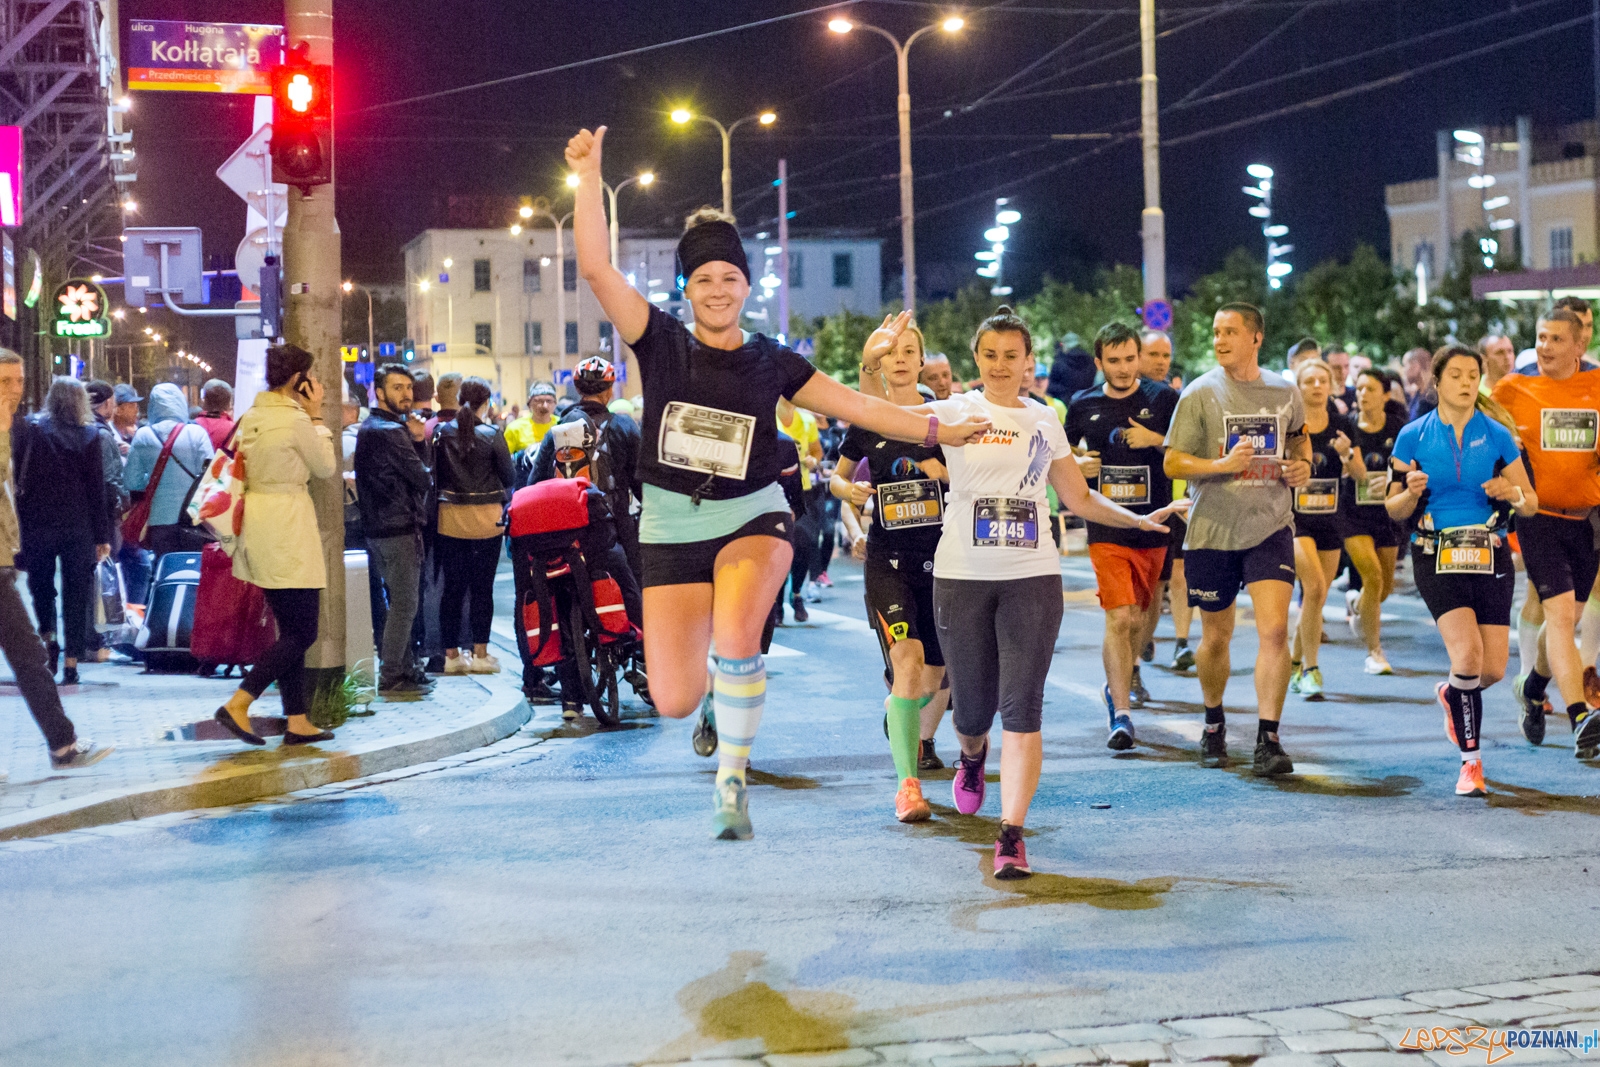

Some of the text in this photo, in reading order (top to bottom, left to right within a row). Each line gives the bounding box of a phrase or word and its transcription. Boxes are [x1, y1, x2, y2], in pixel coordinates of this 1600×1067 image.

[131, 22, 224, 36] ulica Hugona
[151, 39, 260, 68] Kołłątaja
[148, 70, 211, 82] Przedmieście
[56, 319, 103, 336] Fresh
[1554, 429, 1586, 443] 10174
[680, 436, 725, 461] 9770
[1110, 485, 1136, 497] 9912
[895, 502, 926, 519] 9180
[988, 521, 1025, 539] 2845
[1451, 549, 1481, 563] 9062
